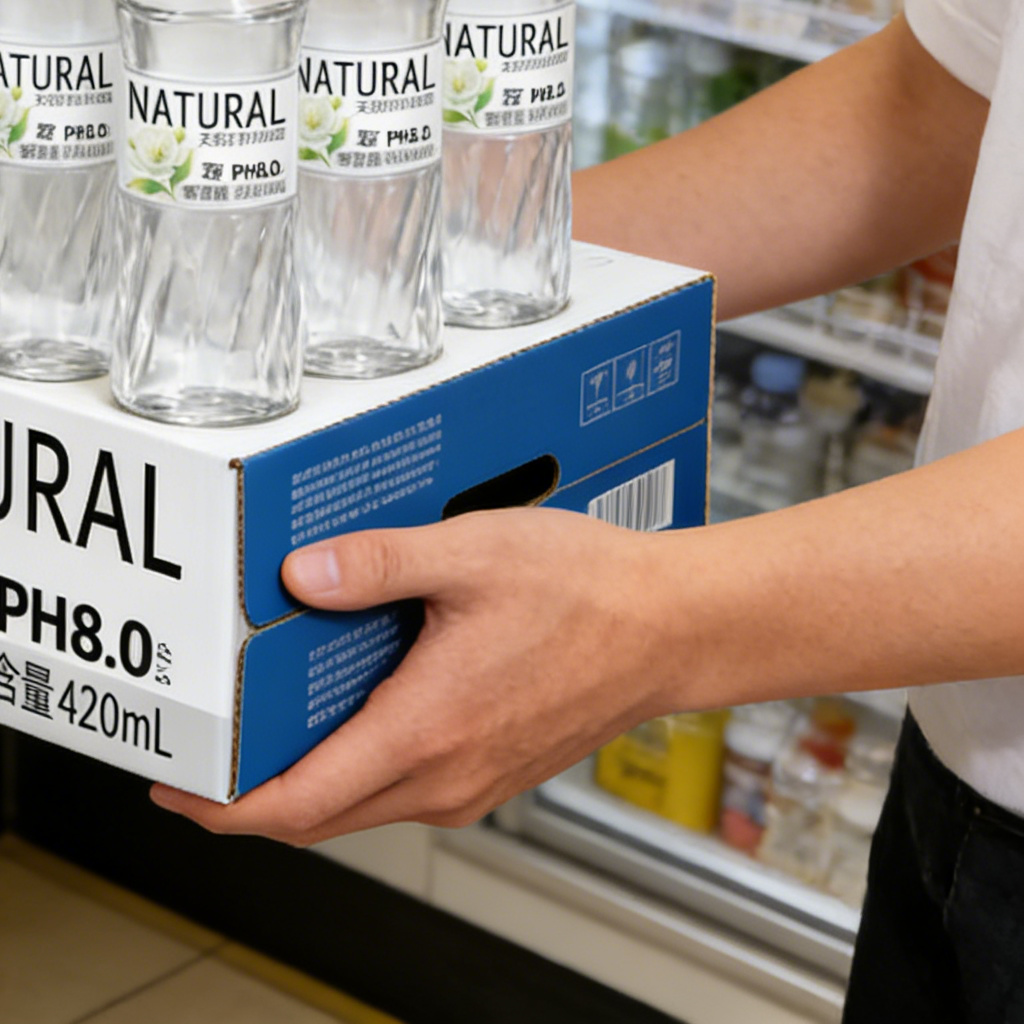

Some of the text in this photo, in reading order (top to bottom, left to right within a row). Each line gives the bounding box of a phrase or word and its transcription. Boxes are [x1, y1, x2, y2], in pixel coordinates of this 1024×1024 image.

[442, 16, 569, 59] NATURAL
[298, 53, 436, 97] NATURAL
[127, 80, 287, 130] NATURAL
